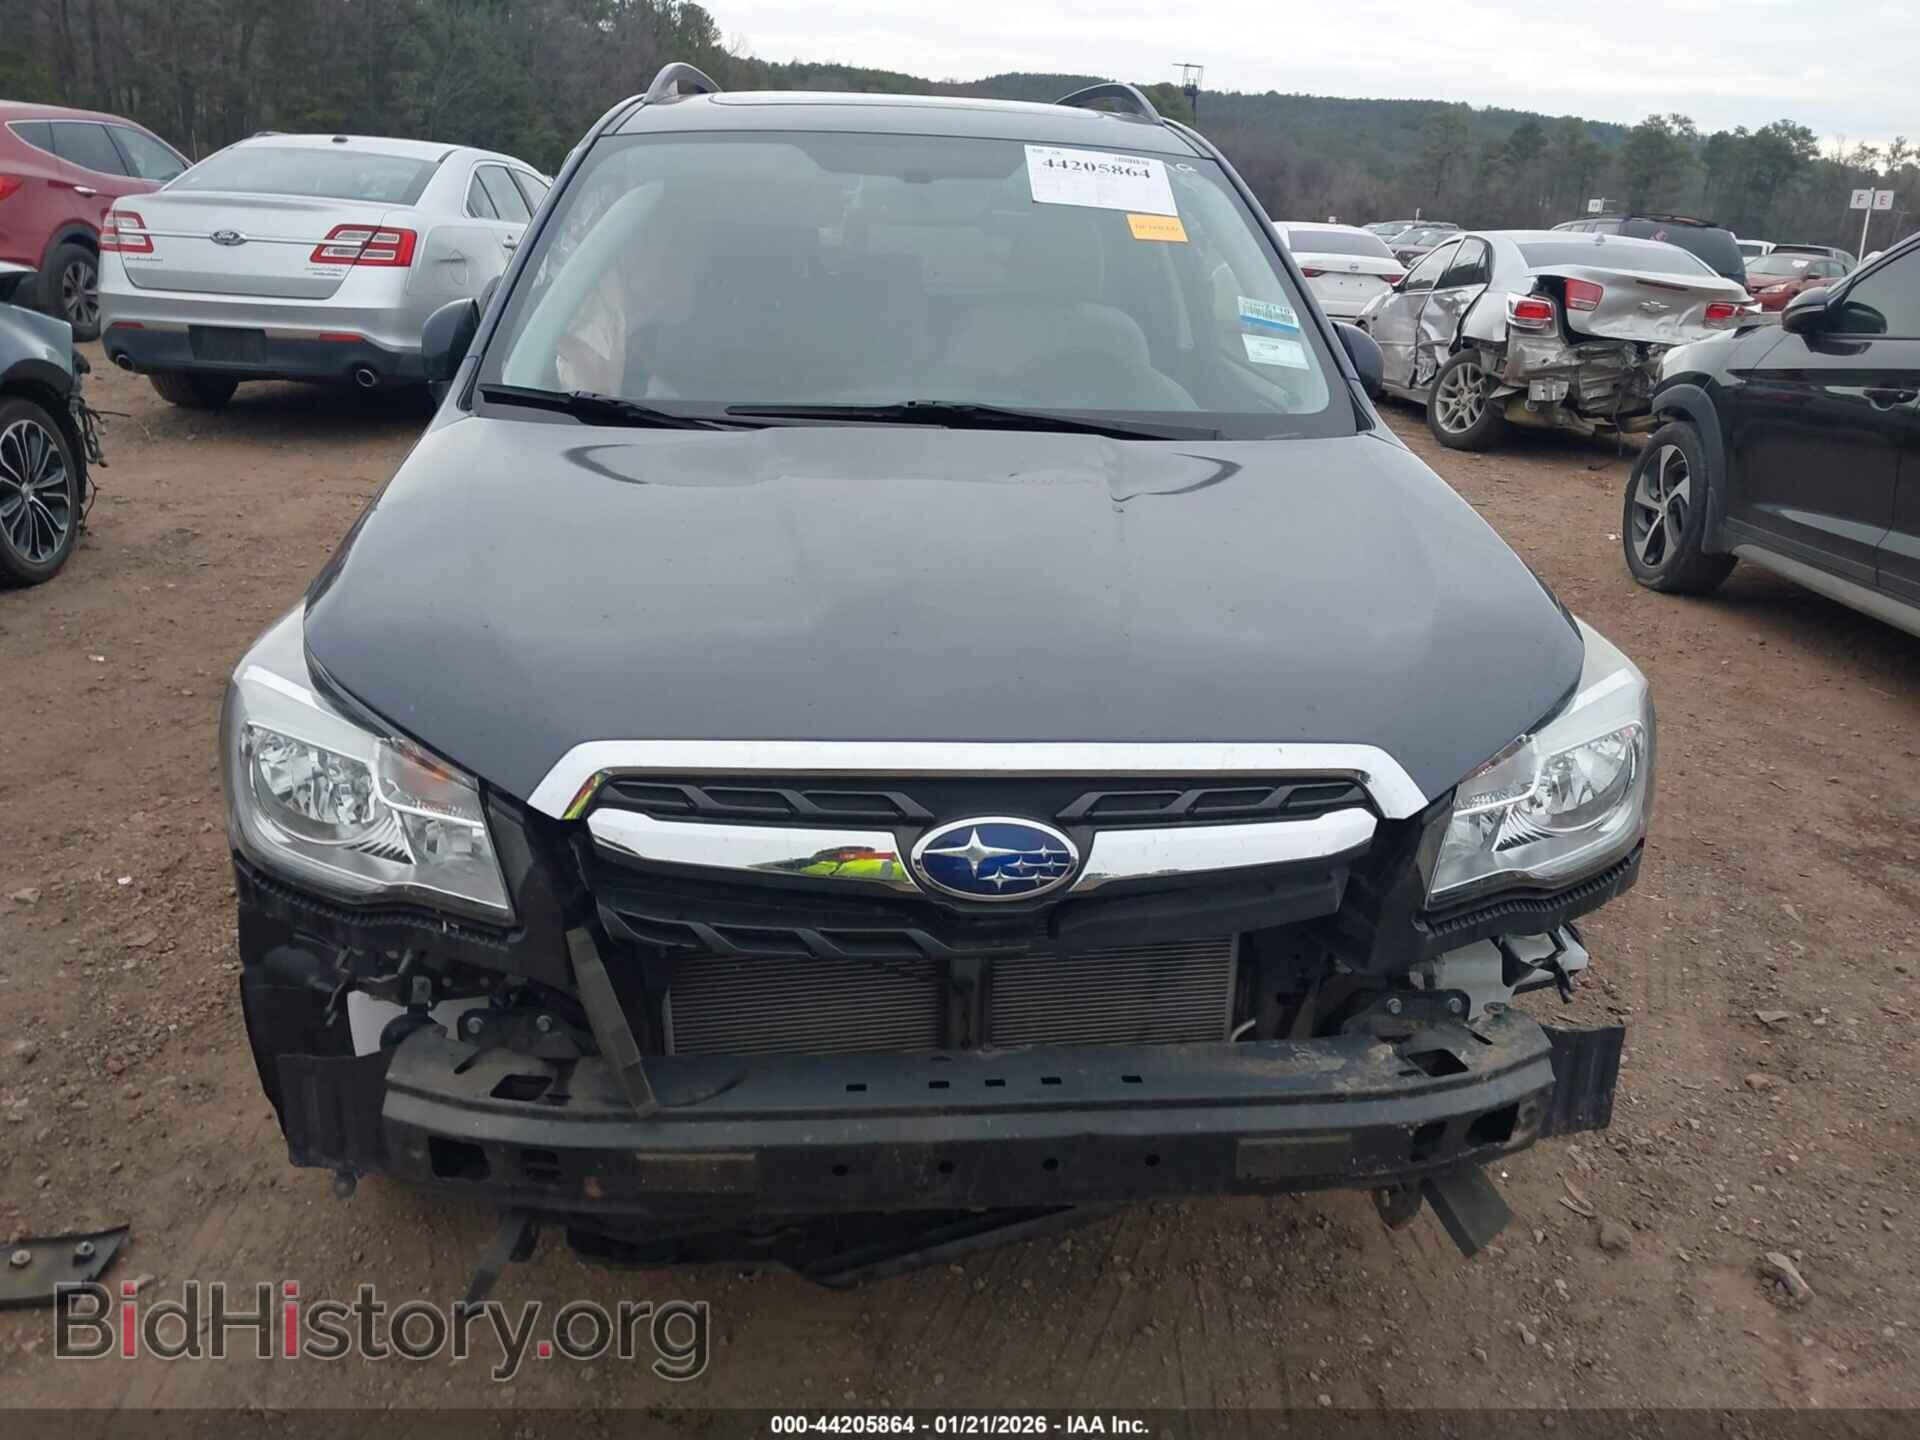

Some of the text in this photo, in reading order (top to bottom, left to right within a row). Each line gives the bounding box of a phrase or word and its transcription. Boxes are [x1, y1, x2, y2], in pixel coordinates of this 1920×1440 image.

[1042, 158, 1152, 179] 44205864
[1856, 193, 1865, 205] F
[1879, 194, 1888, 206] E
